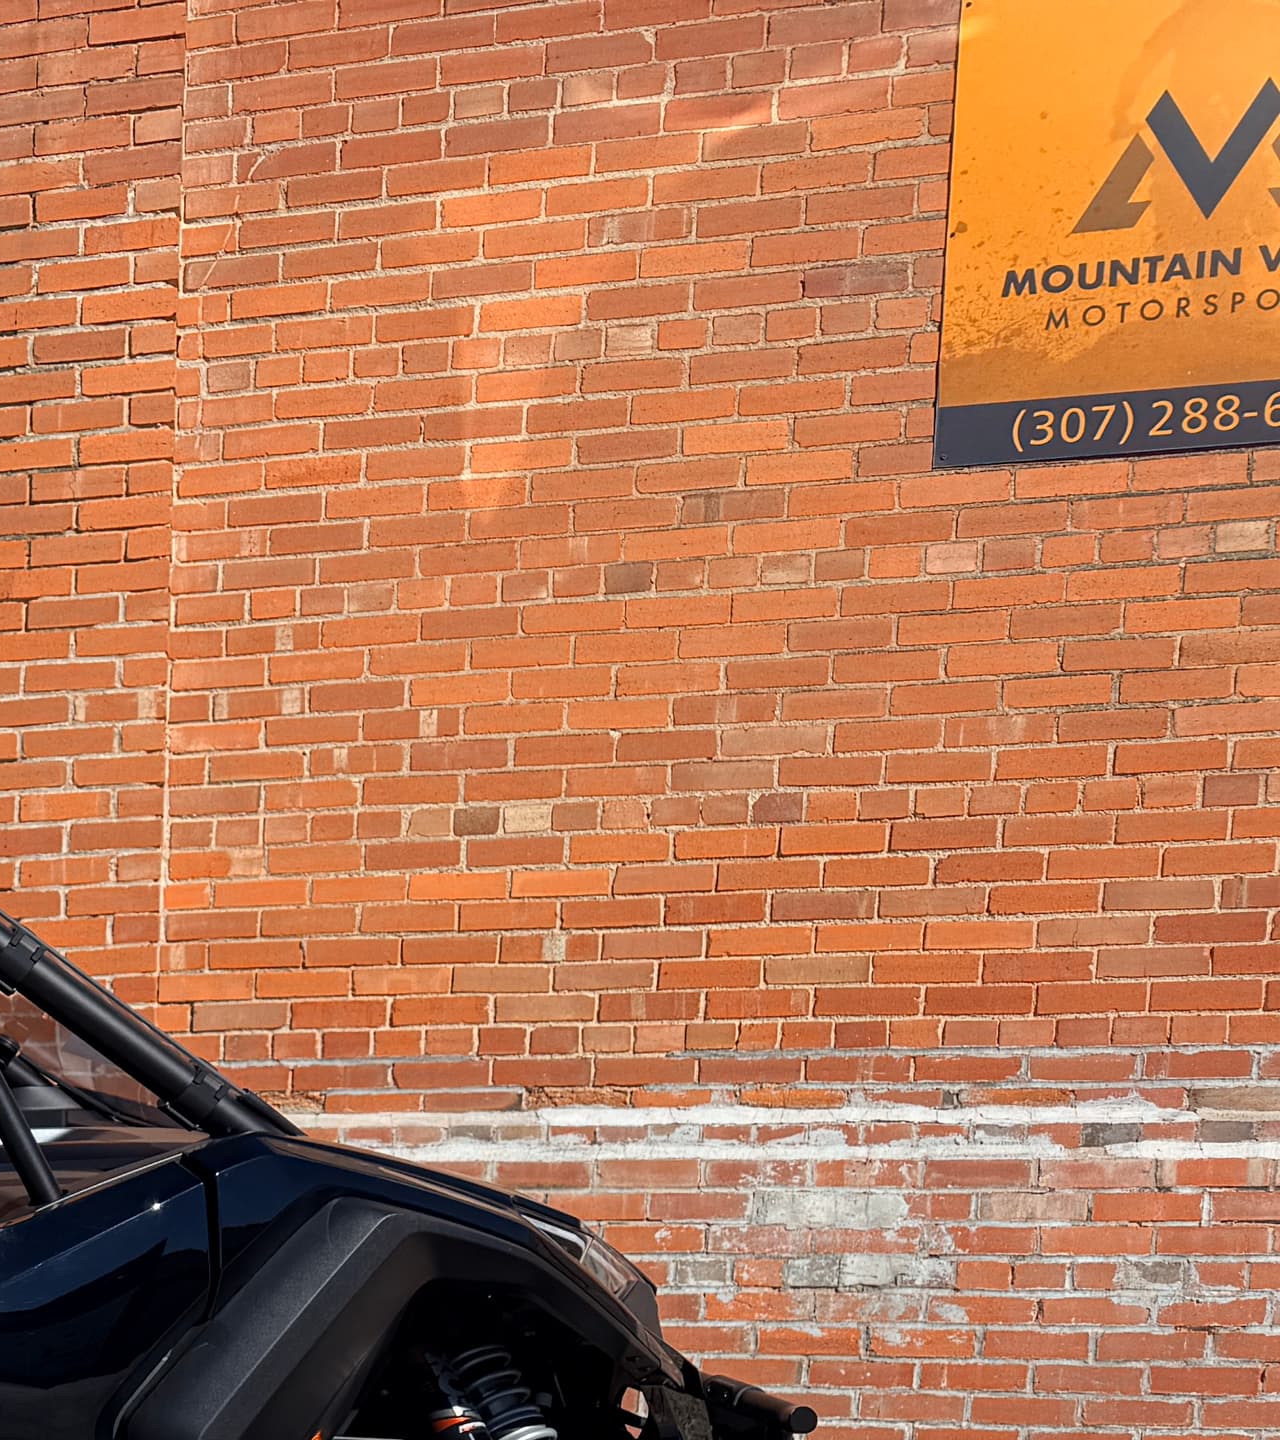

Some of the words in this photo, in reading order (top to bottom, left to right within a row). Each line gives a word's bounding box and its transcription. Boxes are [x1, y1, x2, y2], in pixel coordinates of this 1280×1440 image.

[1001, 247, 1242, 298] MOUNTAIN
[1044, 288, 1280, 331] MOTORSPO
[1011, 400, 1136, 453] (307)
